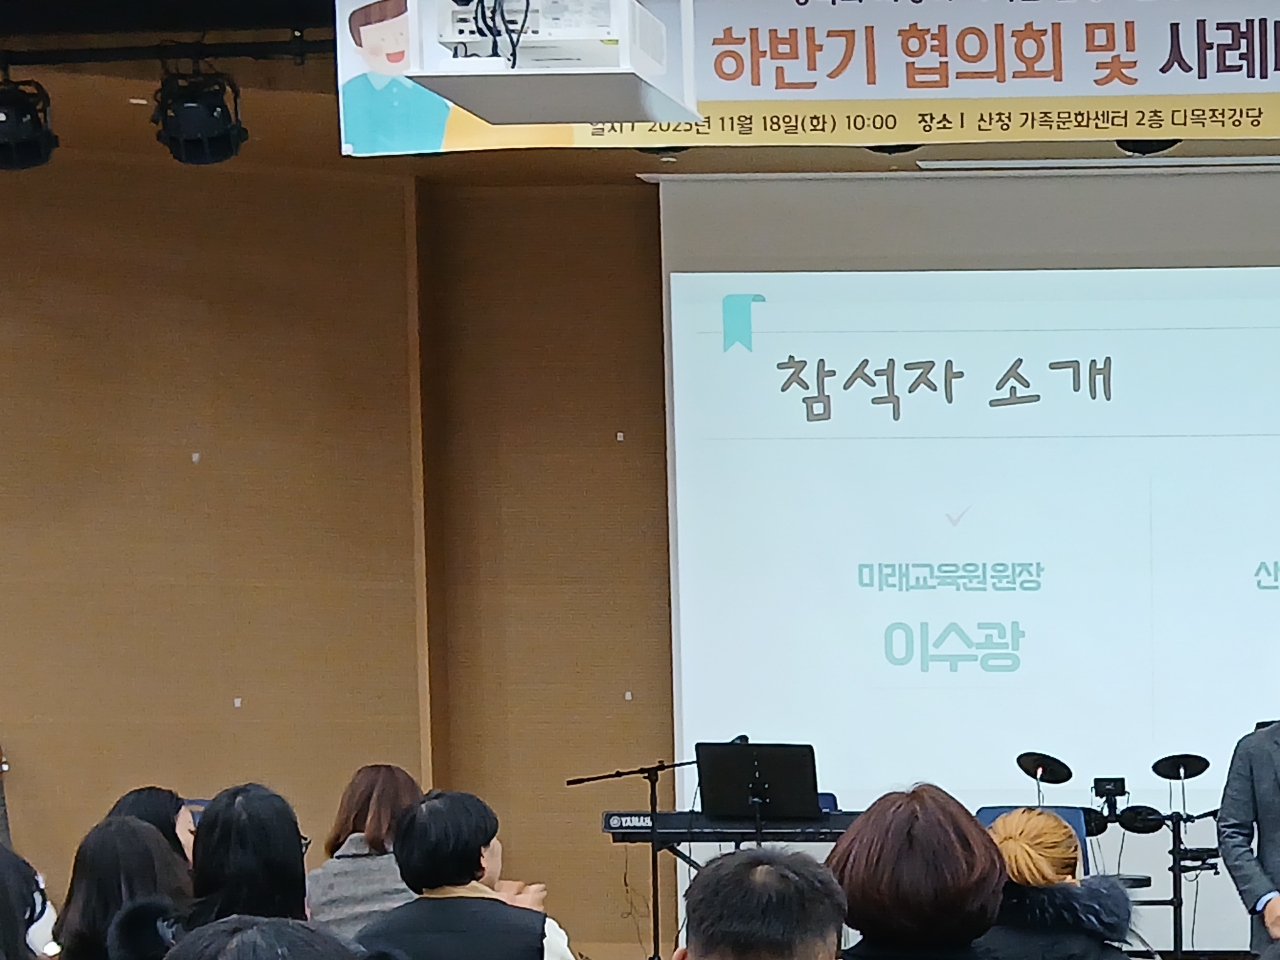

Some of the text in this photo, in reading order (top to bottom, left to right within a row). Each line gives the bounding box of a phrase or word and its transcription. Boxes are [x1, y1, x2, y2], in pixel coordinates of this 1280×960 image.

[711, 25, 877, 90] 하반기
[897, 22, 1063, 89] 협의회
[1084, 20, 1139, 86] 및
[719, 114, 753, 135] 11월
[762, 114, 837, 135] 18일(화)
[845, 114, 897, 131] 10:00
[918, 112, 953, 133] 장소
[977, 111, 1012, 132] 산청
[1019, 110, 1128, 130] 가족문화센터
[1135, 109, 1165, 129] 2층
[776, 355, 1112, 422] 참석자 소개
[884, 621, 1026, 673] 이수광
[620, 816, 652, 827] YAMAH
